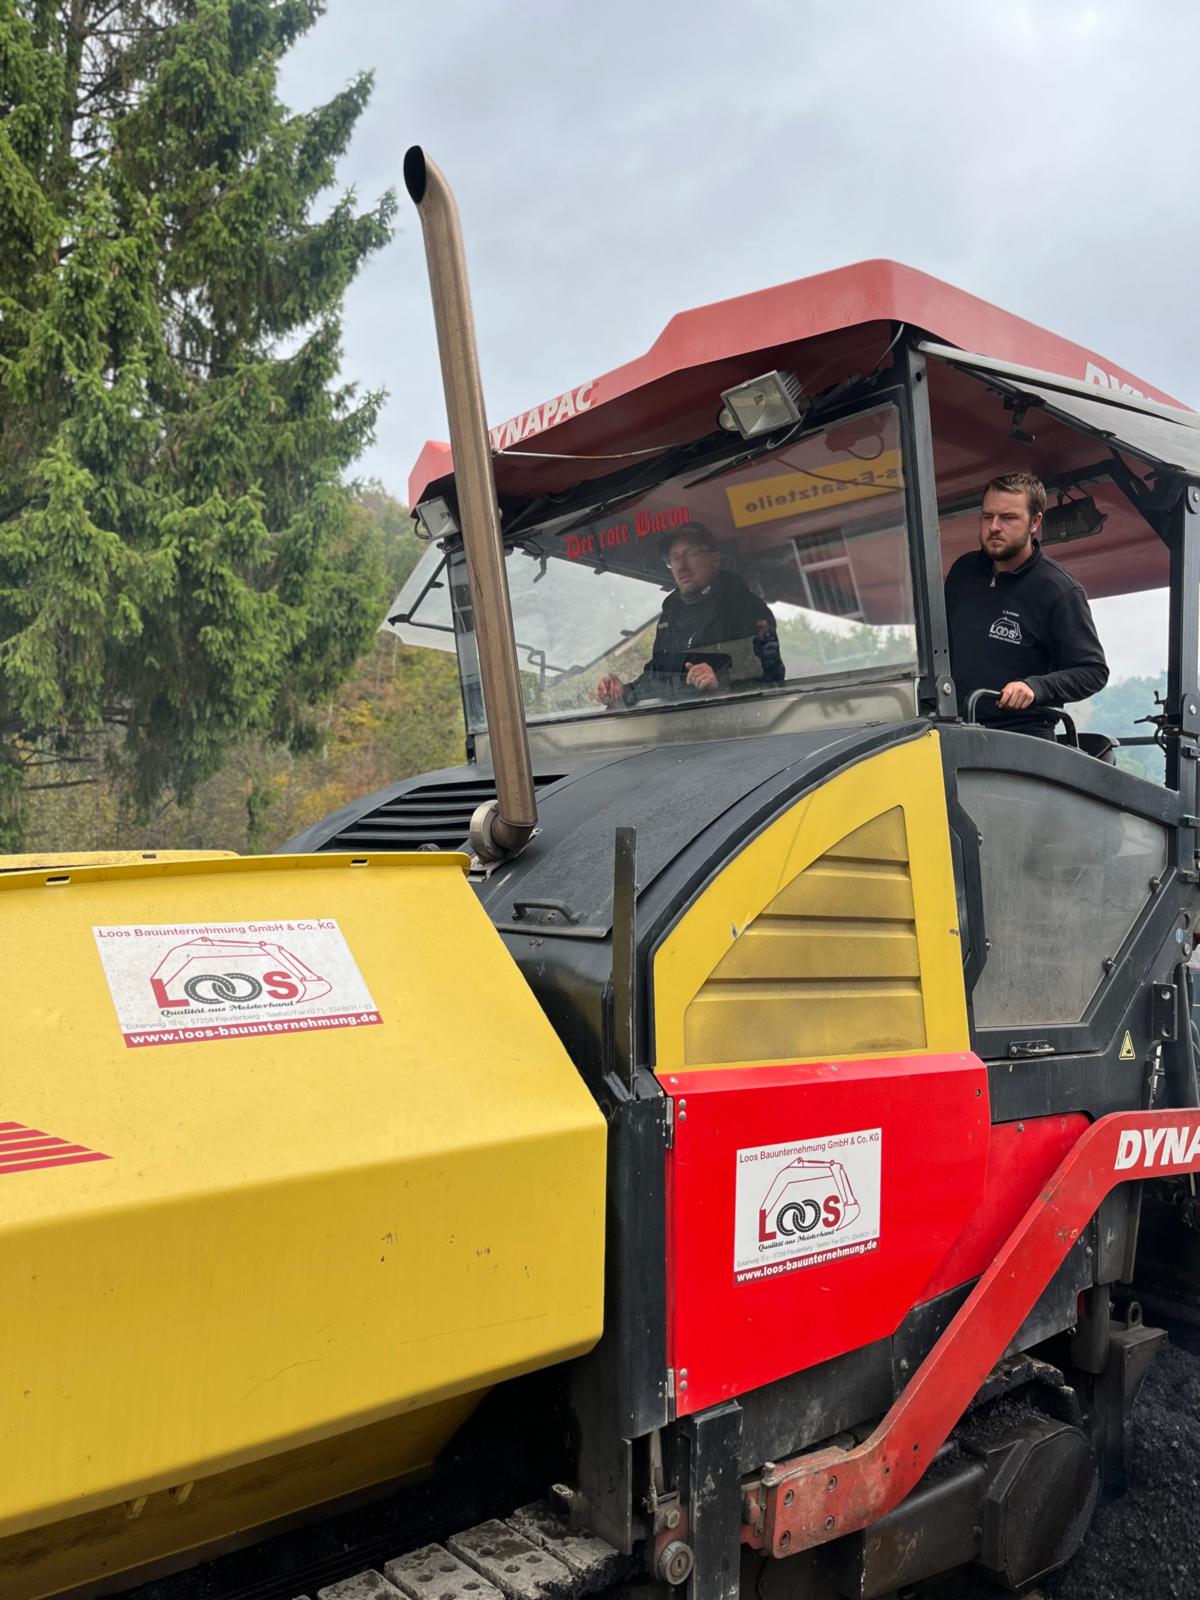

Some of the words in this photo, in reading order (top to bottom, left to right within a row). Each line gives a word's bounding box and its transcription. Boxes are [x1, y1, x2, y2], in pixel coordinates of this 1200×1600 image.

[489, 380, 592, 452] YNAPAC
[564, 535, 594, 559] Der
[599, 522, 629, 549] rote
[633, 505, 689, 537] Baron
[990, 624, 1015, 639] LOOS
[98, 929, 131, 938] Loos
[134, 926, 247, 937] Bauunternehmung
[248, 923, 285, 933] GmbH
[287, 923, 295, 931] &
[297, 922, 317, 931] Co.
[318, 921, 336, 930] KG
[150, 970, 299, 1009] LOOS
[160, 1007, 205, 1018] Qualität
[229, 1001, 295, 1012] Meisterhand
[130, 1013, 378, 1044] www.loos-bauunternehmung.de
[739, 1151, 759, 1163] Loos
[760, 1142, 826, 1160] Bauunternehmung
[827, 1136, 849, 1149] GmbH
[850, 1136, 856, 1145] &
[856, 1134, 868, 1144] Co.
[869, 1132, 880, 1142] KG
[758, 1194, 841, 1243] LOOS
[758, 1239, 784, 1253] Qualität
[784, 1238, 796, 1247] aus
[797, 1229, 836, 1243] Meisterhand
[736, 1240, 878, 1282] www.loos-bauunternehmung.de
